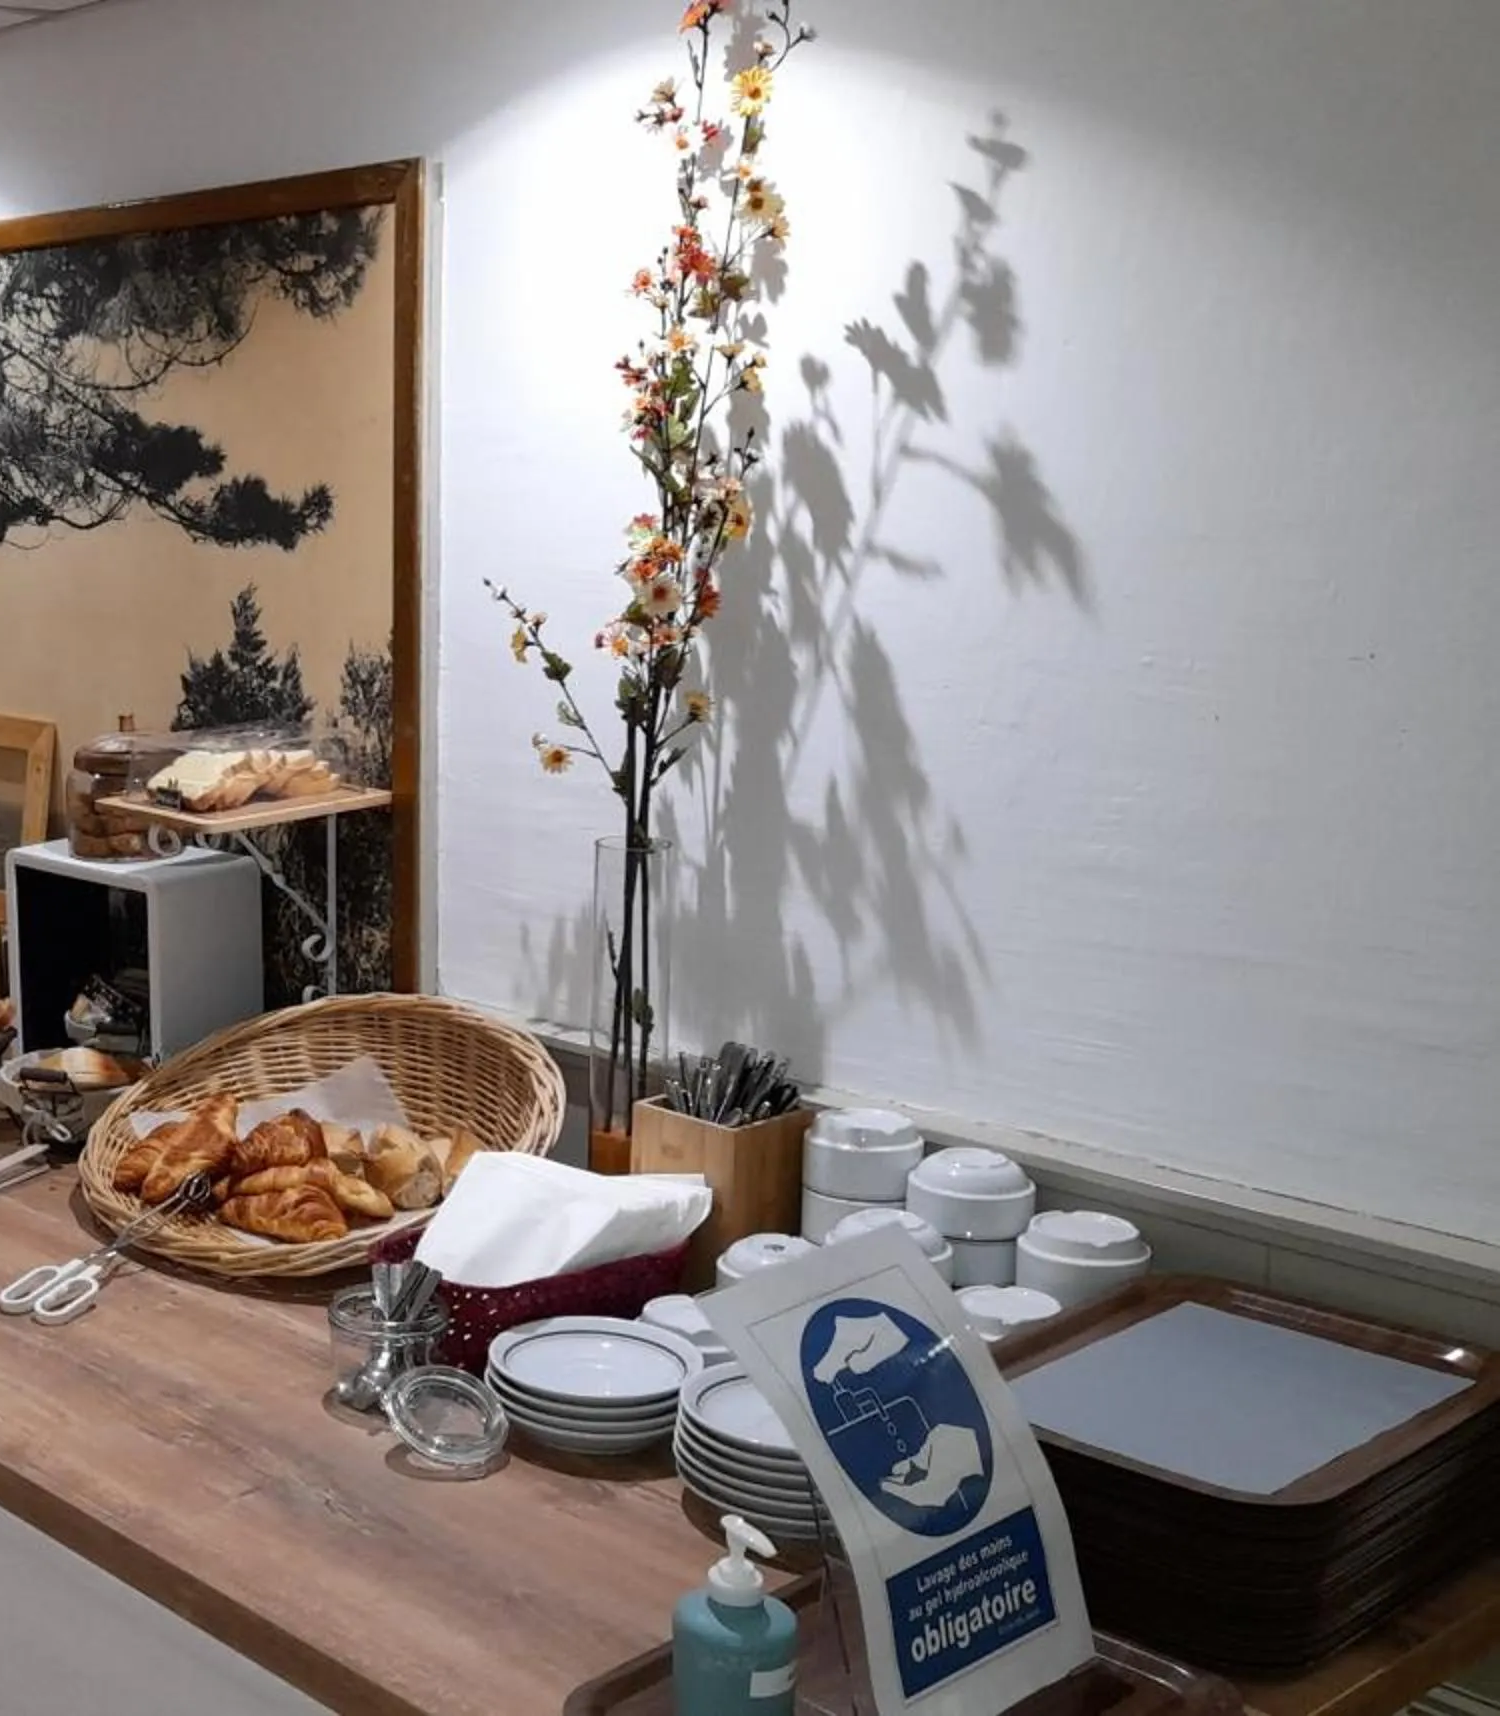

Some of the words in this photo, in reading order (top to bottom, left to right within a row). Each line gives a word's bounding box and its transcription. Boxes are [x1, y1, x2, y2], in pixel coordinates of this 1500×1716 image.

[908, 1605, 923, 1622] au
[925, 1589, 943, 1616] gel
[943, 1550, 1029, 1604] hydroalcoolique
[916, 1564, 957, 1593] Lavage
[958, 1552, 979, 1571] des
[980, 1535, 1013, 1559] mains
[911, 1578, 1037, 1663] obligatoire
